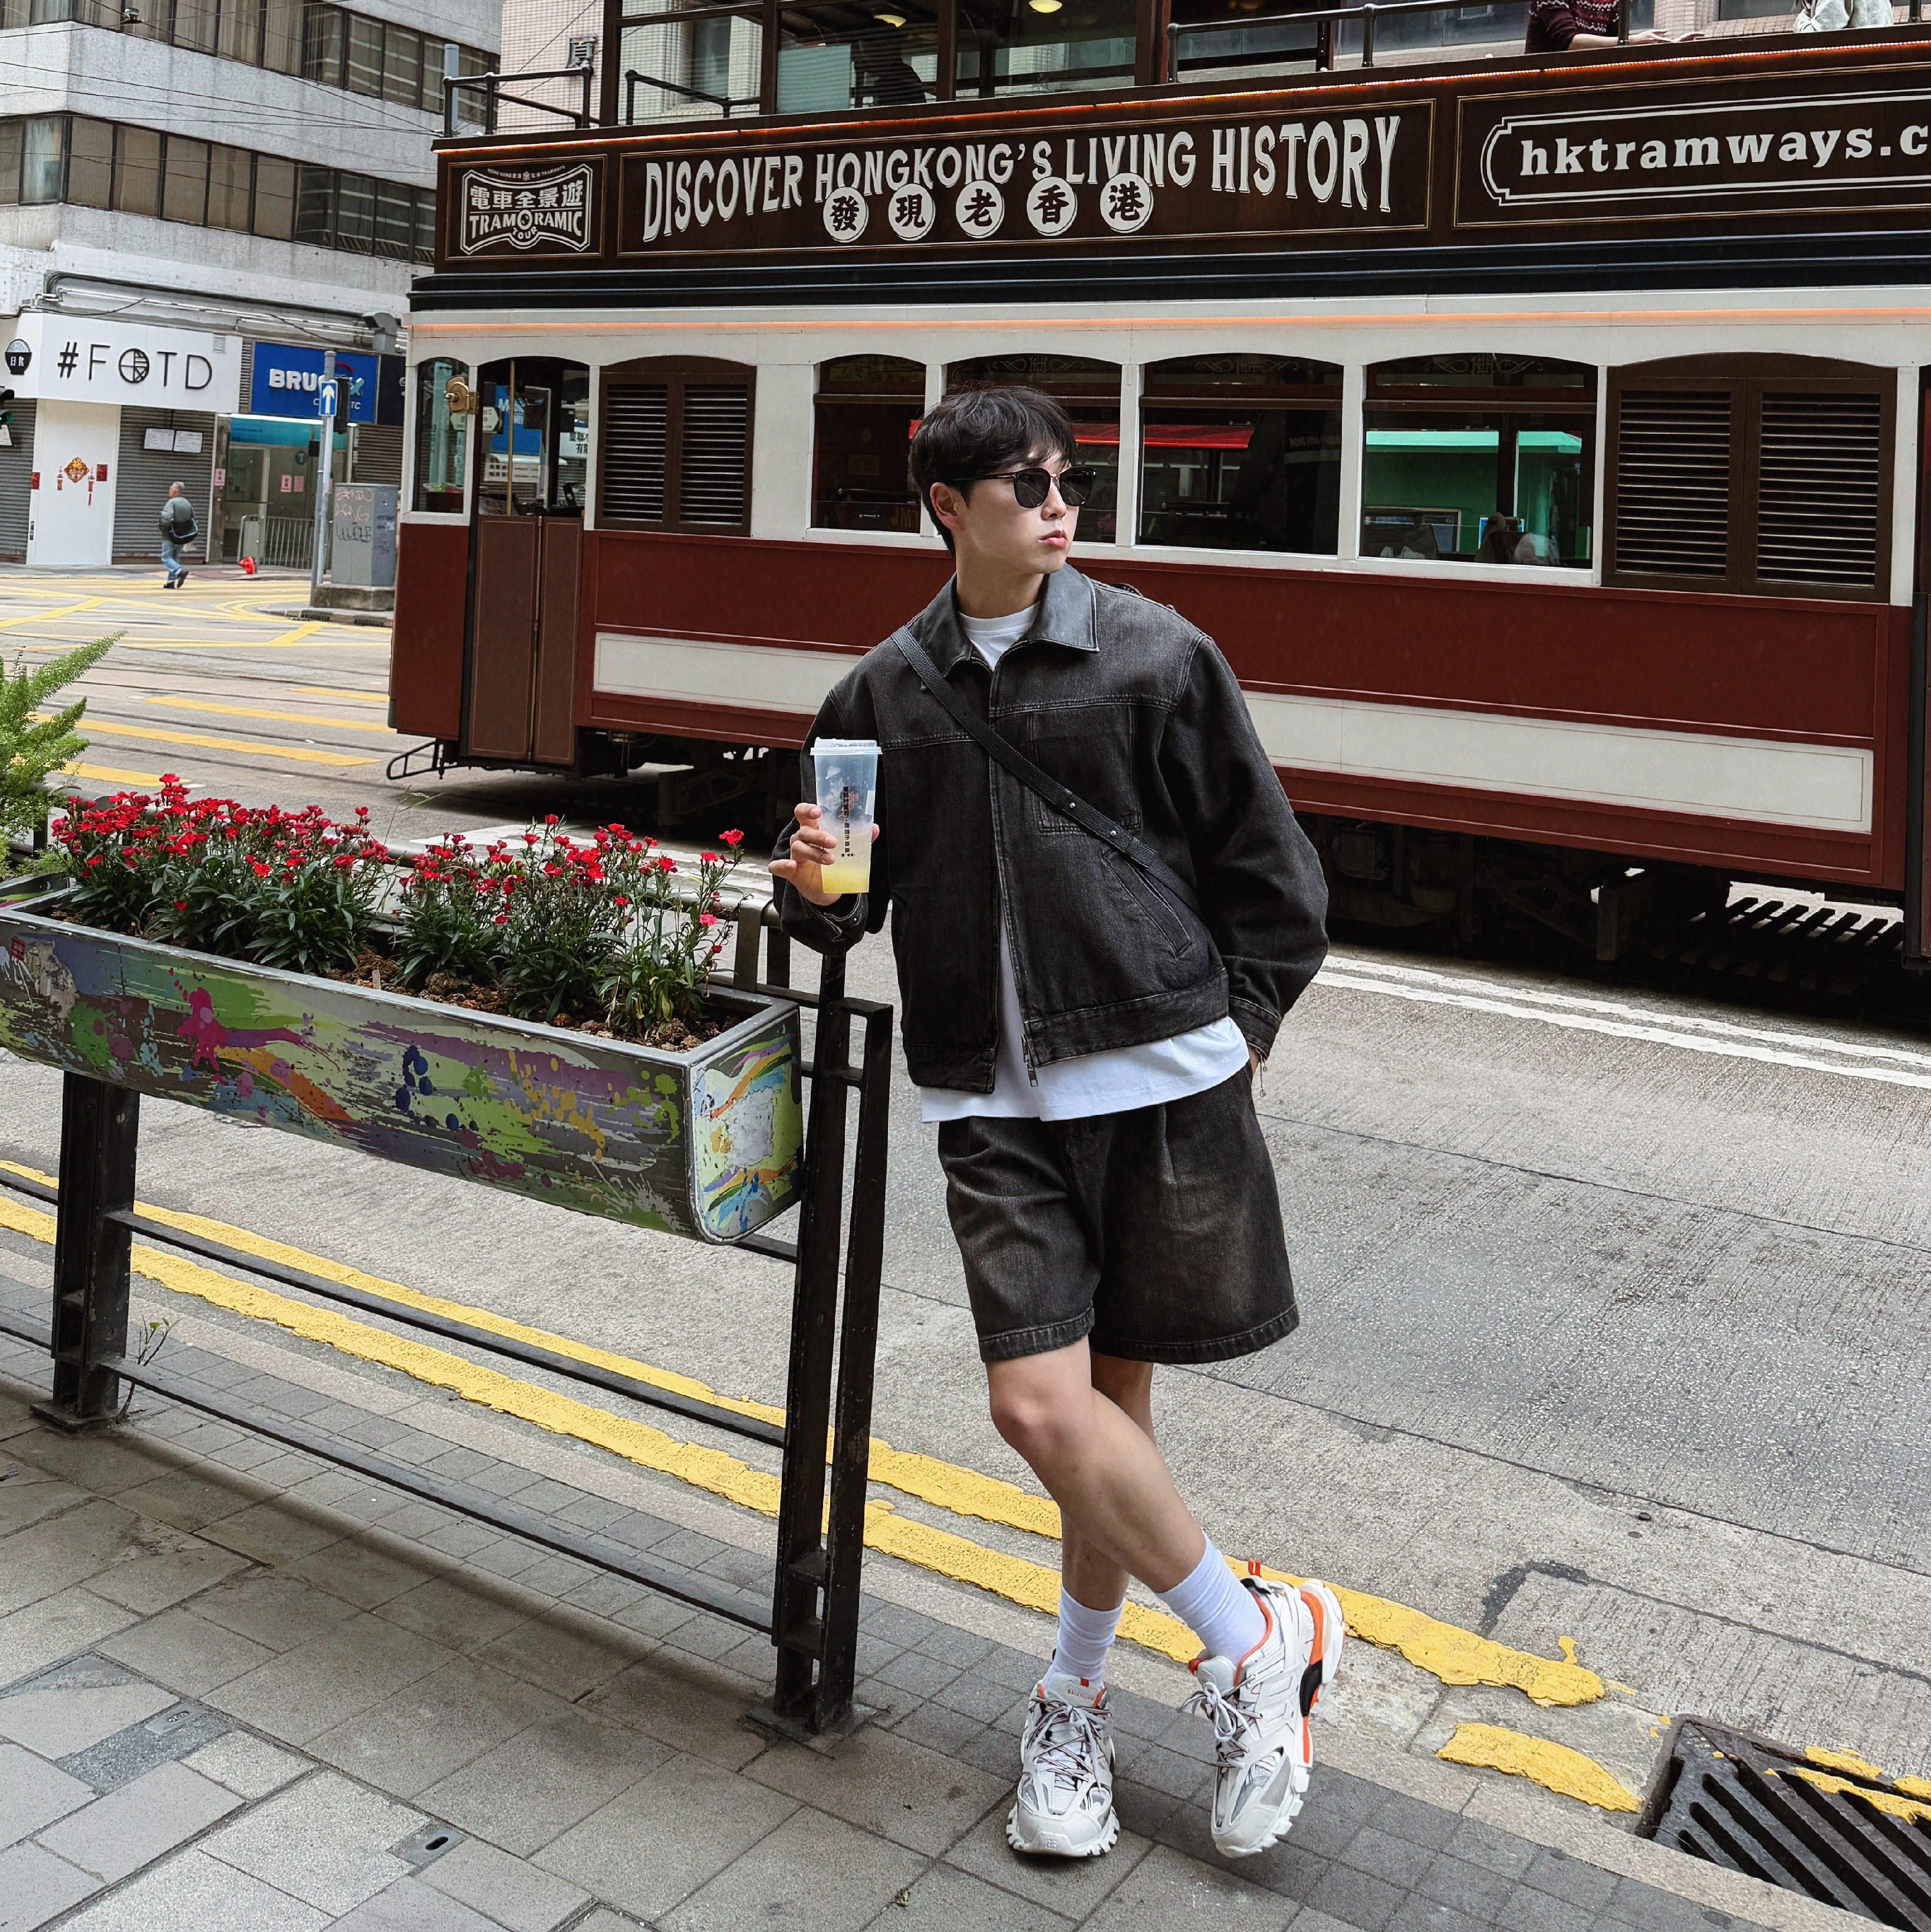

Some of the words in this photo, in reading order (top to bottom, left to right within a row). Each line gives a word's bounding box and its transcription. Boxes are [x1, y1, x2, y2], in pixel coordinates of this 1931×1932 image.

[1520, 124, 1929, 176] hktramways.c
[470, 179, 583, 210] 電車全景遊
[643, 158, 803, 242] DISCOVER
[1066, 131, 1196, 188] LIVING
[1210, 116, 1401, 212] HISTORY
[469, 209, 583, 239] TRAMORAMIC
[828, 179, 1146, 232] 發現老香港
[512, 226, 538, 239] TOUR
[58, 341, 213, 390] #FOTD
